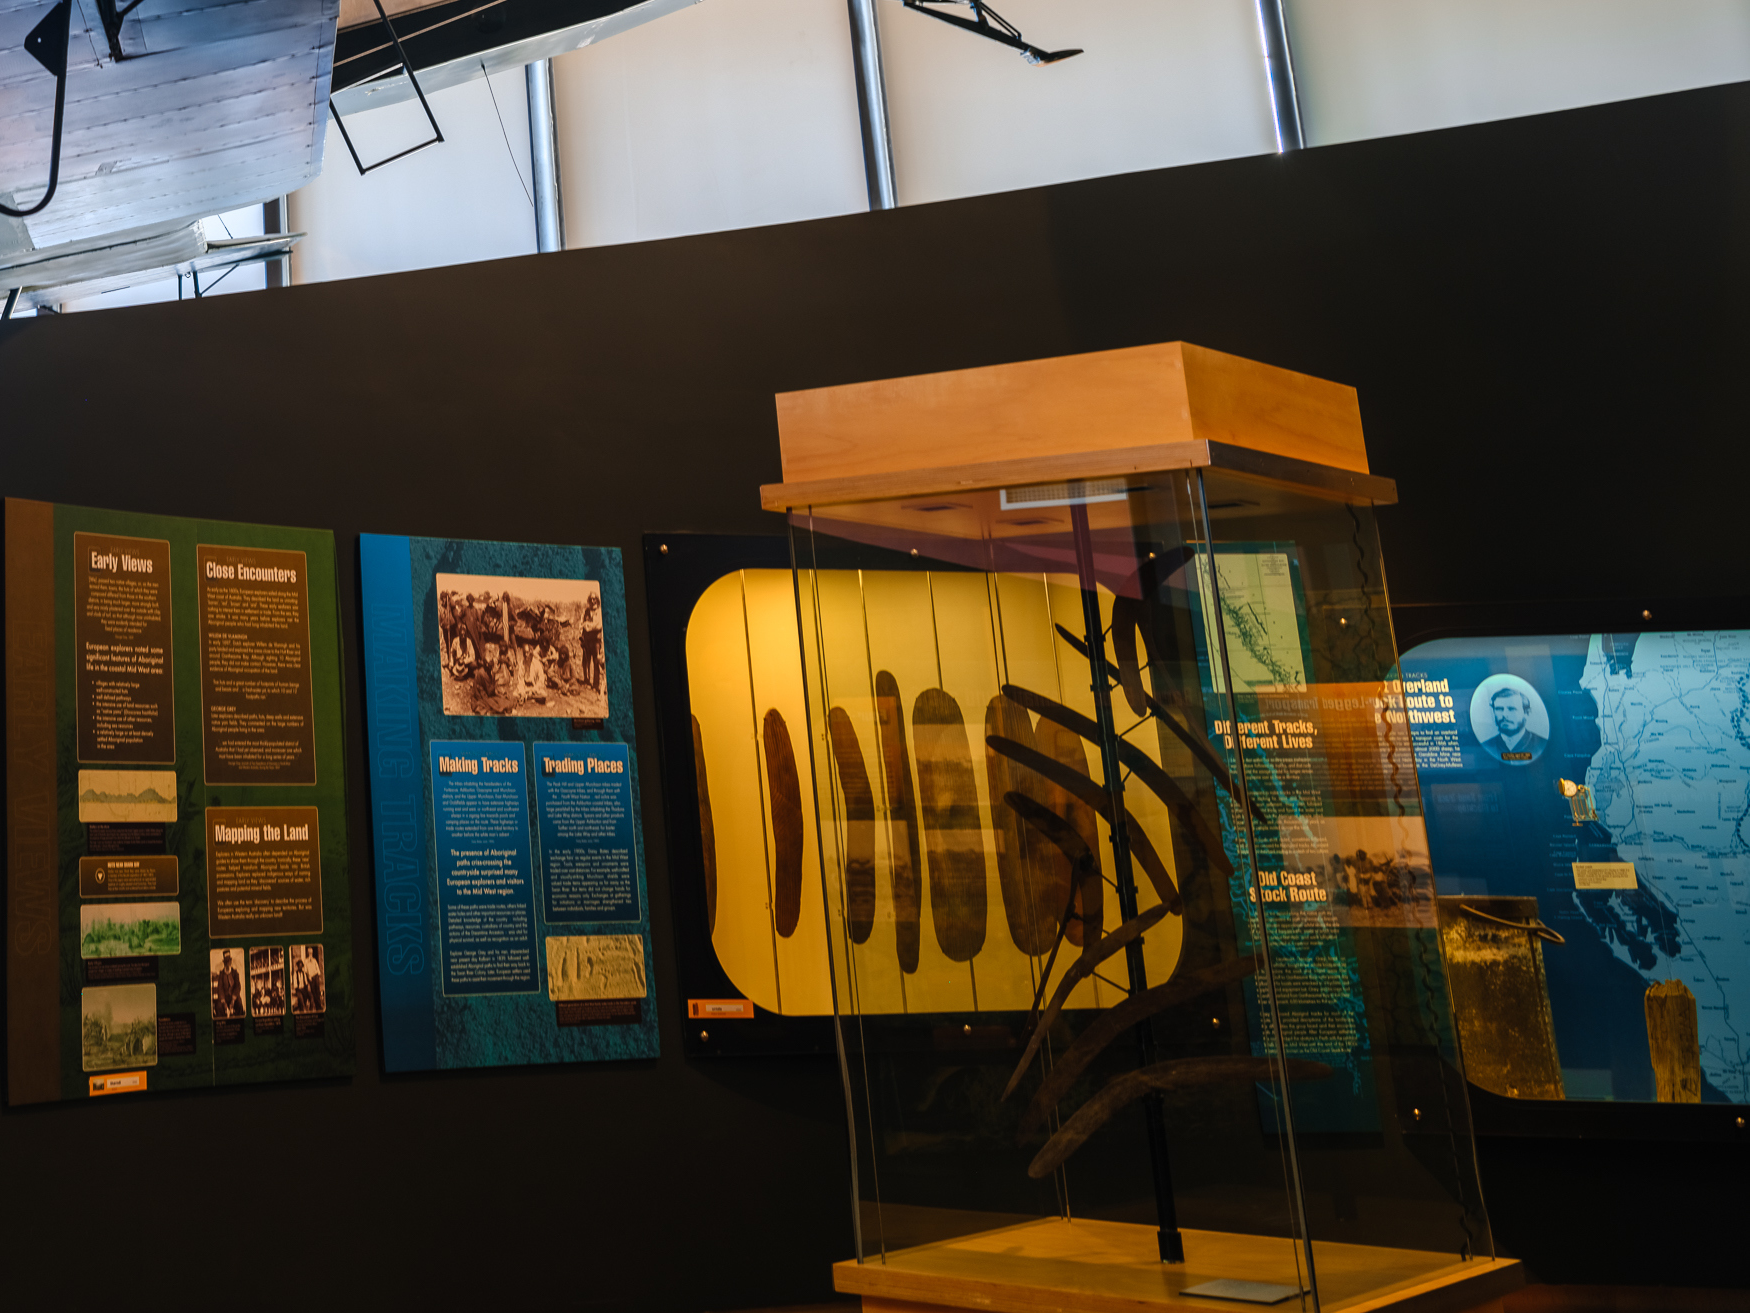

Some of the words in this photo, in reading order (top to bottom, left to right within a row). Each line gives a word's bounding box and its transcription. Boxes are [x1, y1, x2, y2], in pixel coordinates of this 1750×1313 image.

[92, 551, 118, 573] Early
[122, 554, 153, 573] Views
[207, 561, 234, 579] Close
[238, 564, 296, 583] Encounters
[86, 642, 109, 652] European
[111, 644, 133, 653] explorers
[135, 645, 148, 653] noted
[111, 653, 130, 662] features
[132, 655, 136, 663] of
[138, 655, 163, 666] Aboriginal
[95, 663, 99, 671] in
[109, 664, 126, 672] coastal
[127, 665, 136, 673] Mid
[138, 666, 150, 674] West
[372, 603, 415, 778] MAKING
[1439, 694, 1453, 708] to
[1214, 720, 1269, 734] Diferent
[1272, 720, 1318, 735] Tracks,
[1282, 735, 1313, 748] Lives
[439, 756, 478, 774] Making
[481, 757, 518, 773] Tracks
[544, 757, 584, 775] Trading
[587, 758, 623, 773] Places
[215, 825, 260, 844] Mapping
[263, 824, 280, 841] the
[284, 824, 308, 841] Land
[491, 849, 516, 858] Aboriginal
[457, 859, 470, 867] paths
[452, 869, 479, 877] countryside
[481, 869, 503, 877] surprised
[1258, 871, 1277, 886] Old
[1280, 871, 1317, 886] Coast
[381, 794, 425, 976] TRACKS
[447, 878, 470, 887] European
[472, 878, 495, 886] explorers
[1249, 887, 1287, 902] Stock
[1290, 887, 1326, 902] Route
